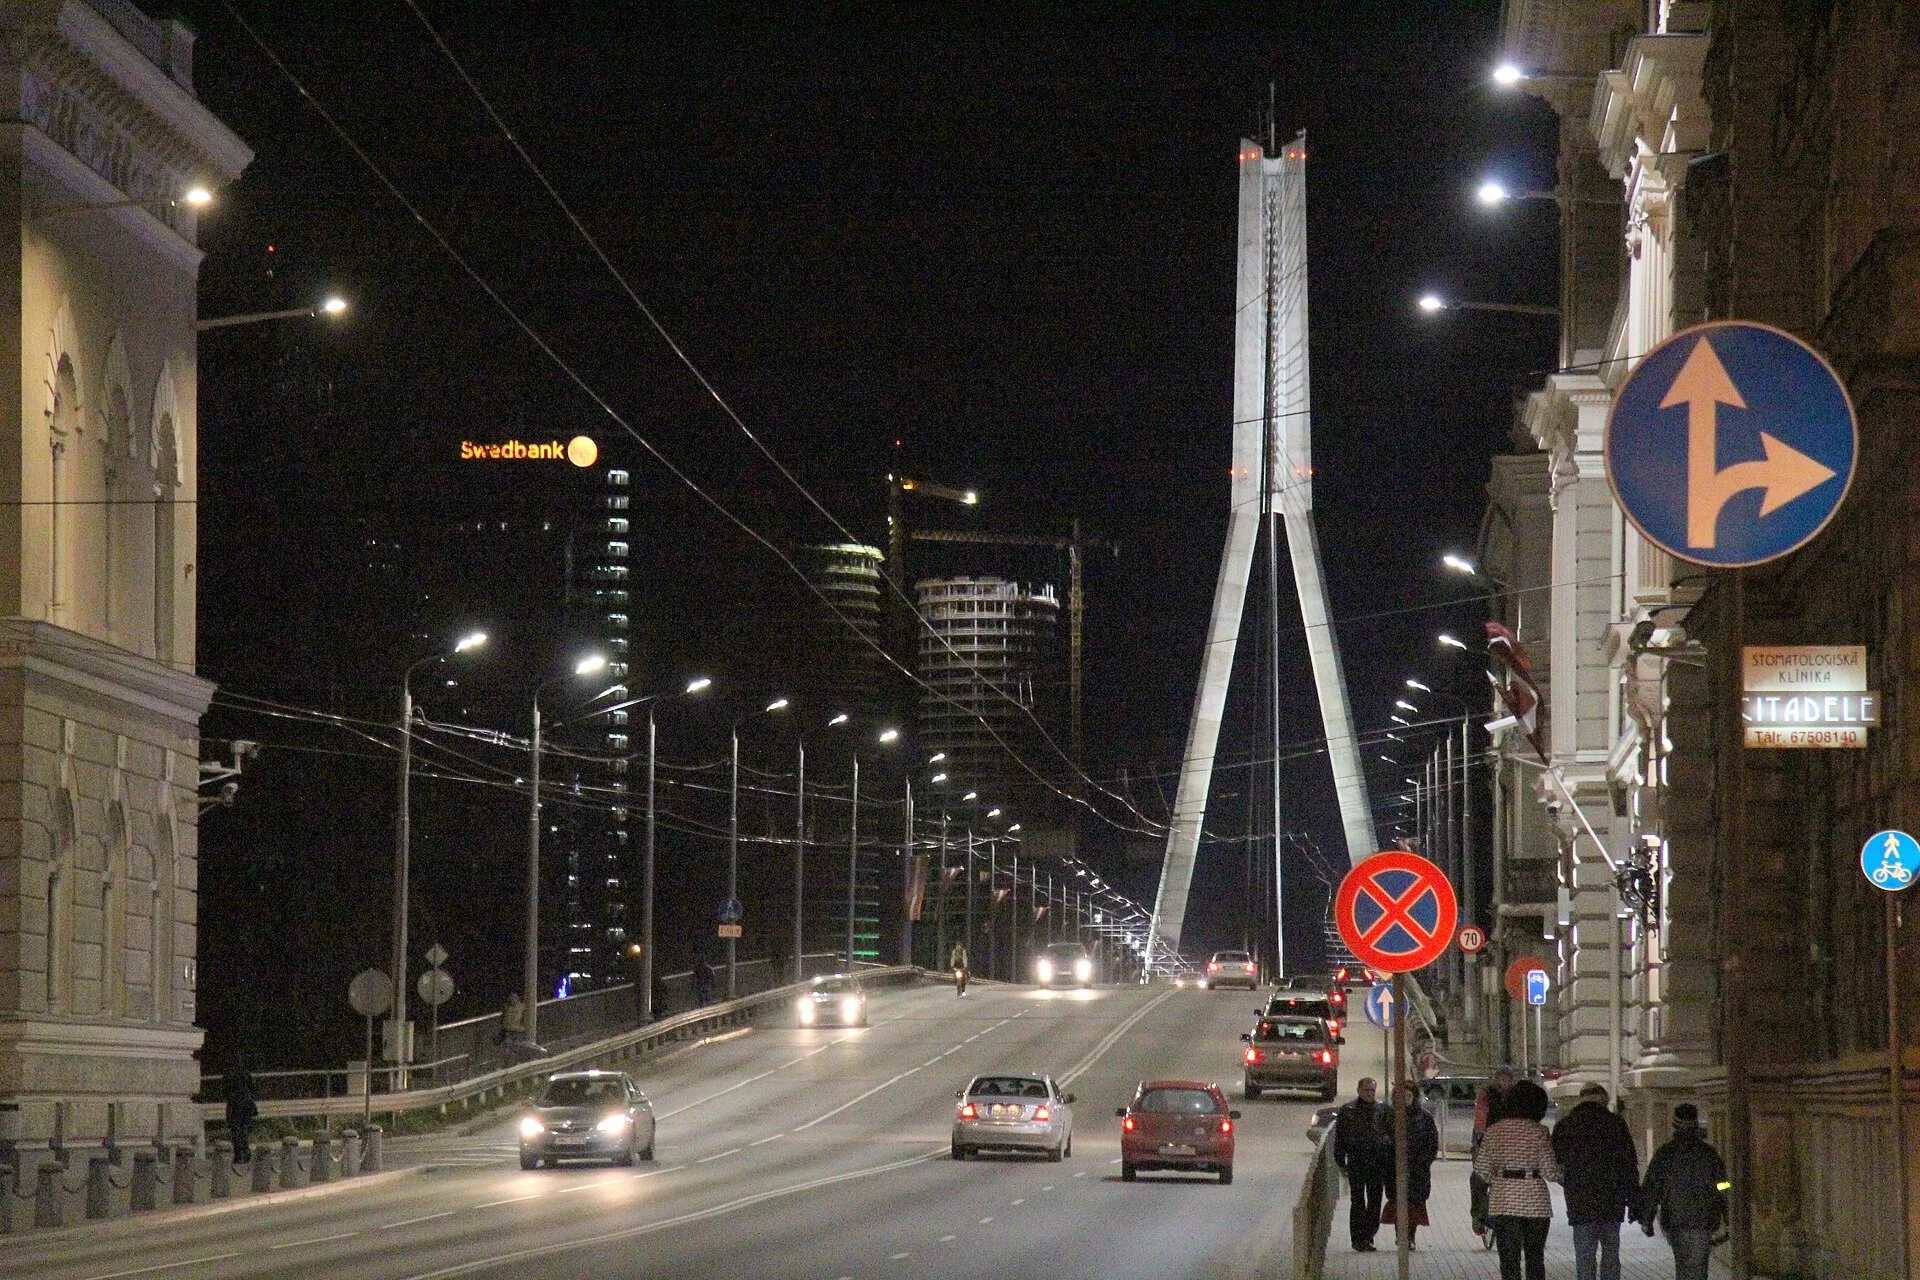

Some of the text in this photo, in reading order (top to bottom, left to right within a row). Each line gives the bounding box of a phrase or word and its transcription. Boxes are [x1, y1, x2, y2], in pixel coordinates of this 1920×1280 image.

[461, 440, 565, 460] Swedbank
[1790, 731, 1857, 743] 67508140
[1464, 932, 1478, 946] 70
